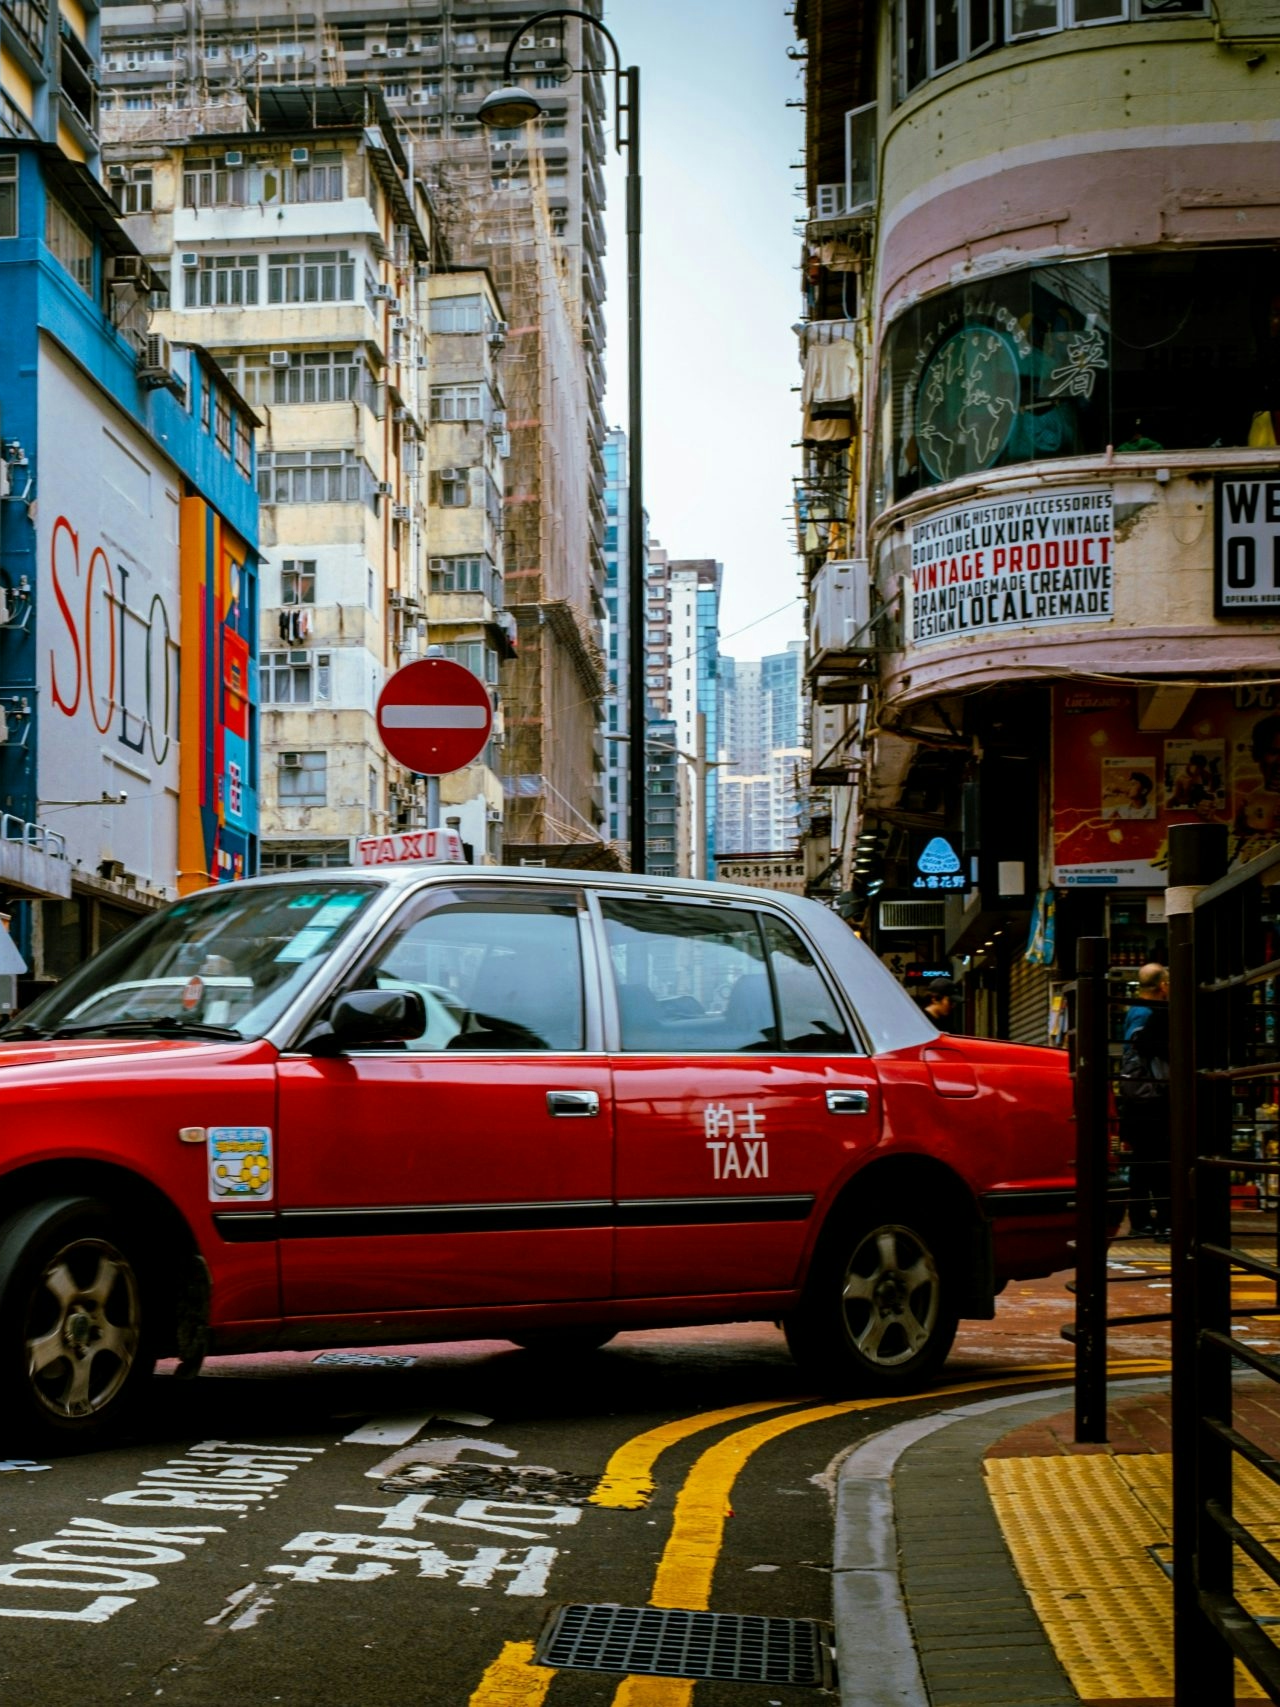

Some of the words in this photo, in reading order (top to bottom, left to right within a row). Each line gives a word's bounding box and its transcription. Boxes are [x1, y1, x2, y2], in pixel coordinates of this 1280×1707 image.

[913, 513, 970, 545] UPCYCLING
[972, 504, 1022, 525] HISTORY
[1024, 494, 1112, 516] ACCESSORIES
[913, 534, 970, 565] BOUTIQUE
[971, 517, 1050, 549] LUXURY
[1052, 514, 1110, 536] VINTAGE
[912, 552, 984, 594] VINTAGE
[993, 537, 1111, 575] PRODUCT
[1228, 536, 1280, 588] O
[913, 587, 957, 619] BRAND
[959, 575, 1026, 599] HADEMADE
[1030, 566, 1112, 594] CREATIVE
[913, 611, 955, 639] DESIGN
[958, 590, 1033, 628] LOCAL
[1036, 591, 1110, 617] REMADE
[50, 514, 170, 766] SOLO
[359, 831, 437, 866] TAXI
[703, 1102, 766, 1138] 的士
[705, 1141, 769, 1180] TAXI
[86, 1440, 326, 1512] RIGHT
